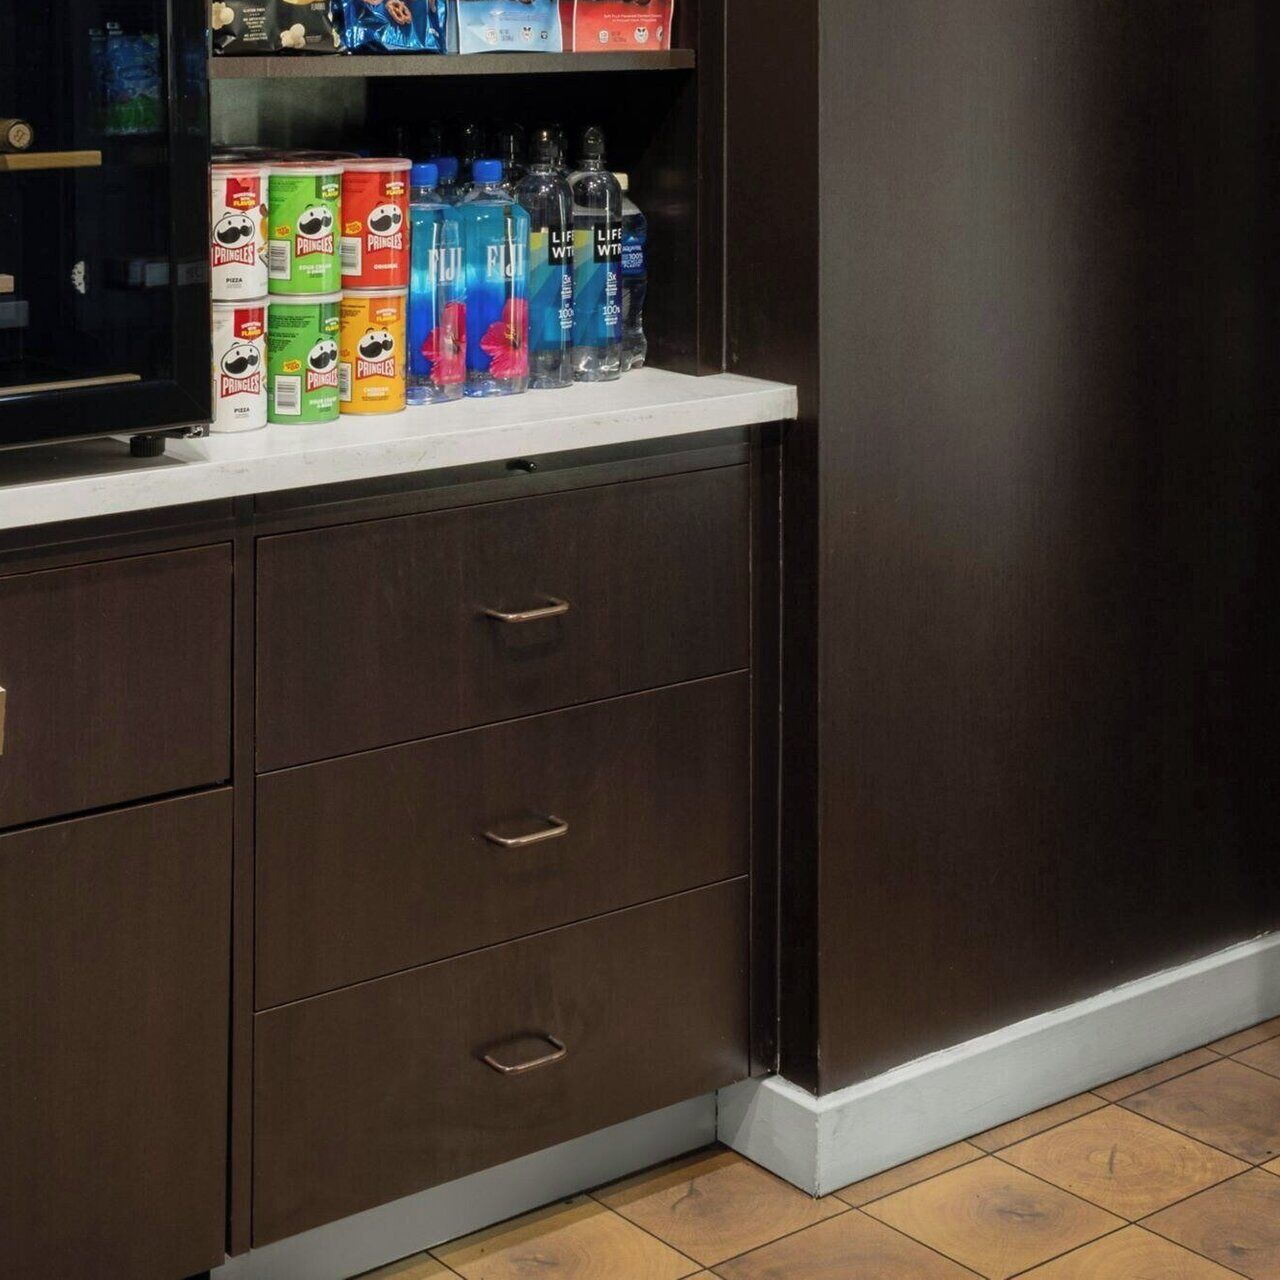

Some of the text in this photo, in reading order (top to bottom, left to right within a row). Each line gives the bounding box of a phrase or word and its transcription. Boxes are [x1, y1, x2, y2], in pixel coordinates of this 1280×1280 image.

[368, 233, 402, 251] PRINGLES
[598, 228, 622, 241] LIFE
[214, 245, 254, 265] PRINGLES
[297, 236, 333, 256] PRINGLES
[428, 247, 463, 283] FIJI
[486, 244, 526, 280] FIJI
[223, 375, 260, 395] PRINGLES
